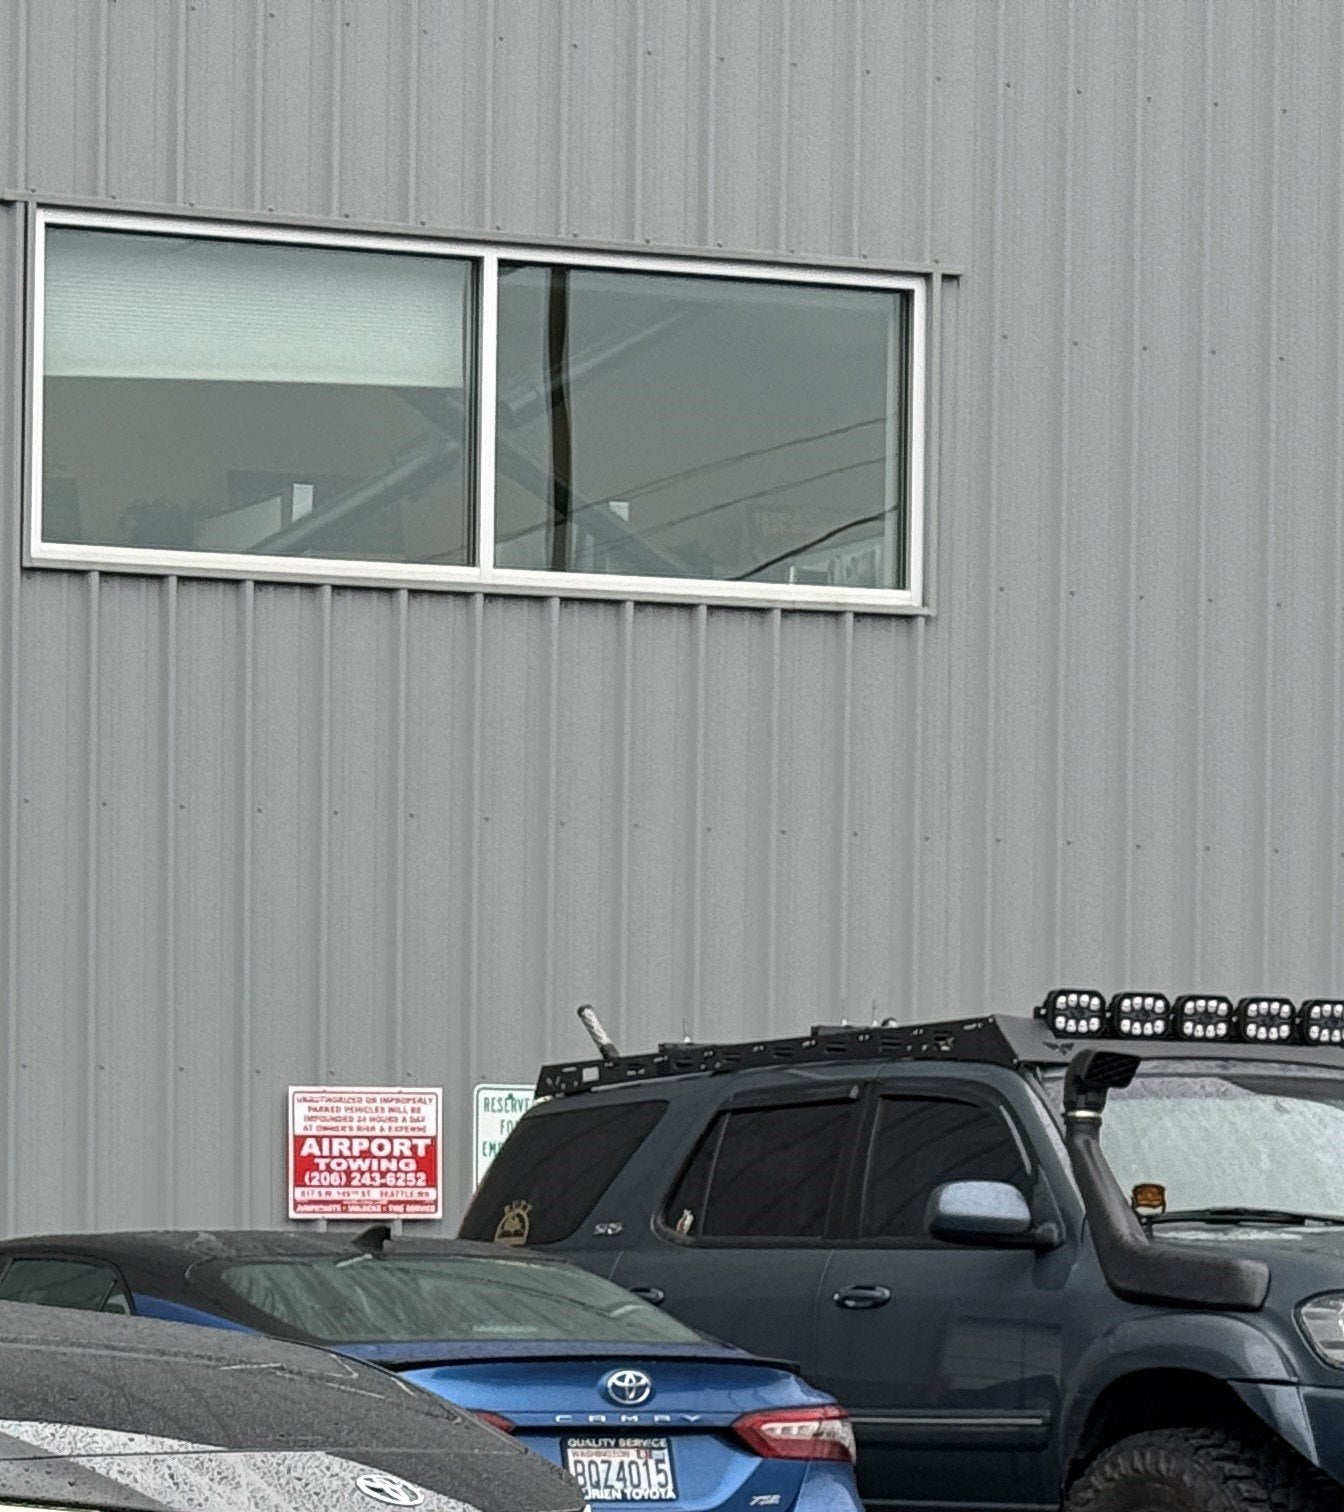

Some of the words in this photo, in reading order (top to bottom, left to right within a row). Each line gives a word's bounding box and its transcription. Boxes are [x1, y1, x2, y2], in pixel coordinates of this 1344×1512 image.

[483, 1096, 531, 1114] RESERVE
[499, 1119, 514, 1136] FO
[300, 1138, 432, 1157] AIRPORT
[313, 1158, 417, 1172] TOWING
[304, 1171, 347, 1186] (206)
[350, 1171, 427, 1187] 243-6252
[555, 1414, 701, 1424] CAMRY
[567, 1438, 616, 1448] QUALITY
[618, 1438, 668, 1448] SERVICE
[573, 1459, 669, 1490] BQZ4015
[581, 1487, 623, 1500] URIEN
[624, 1488, 677, 1500] TOYOTA
